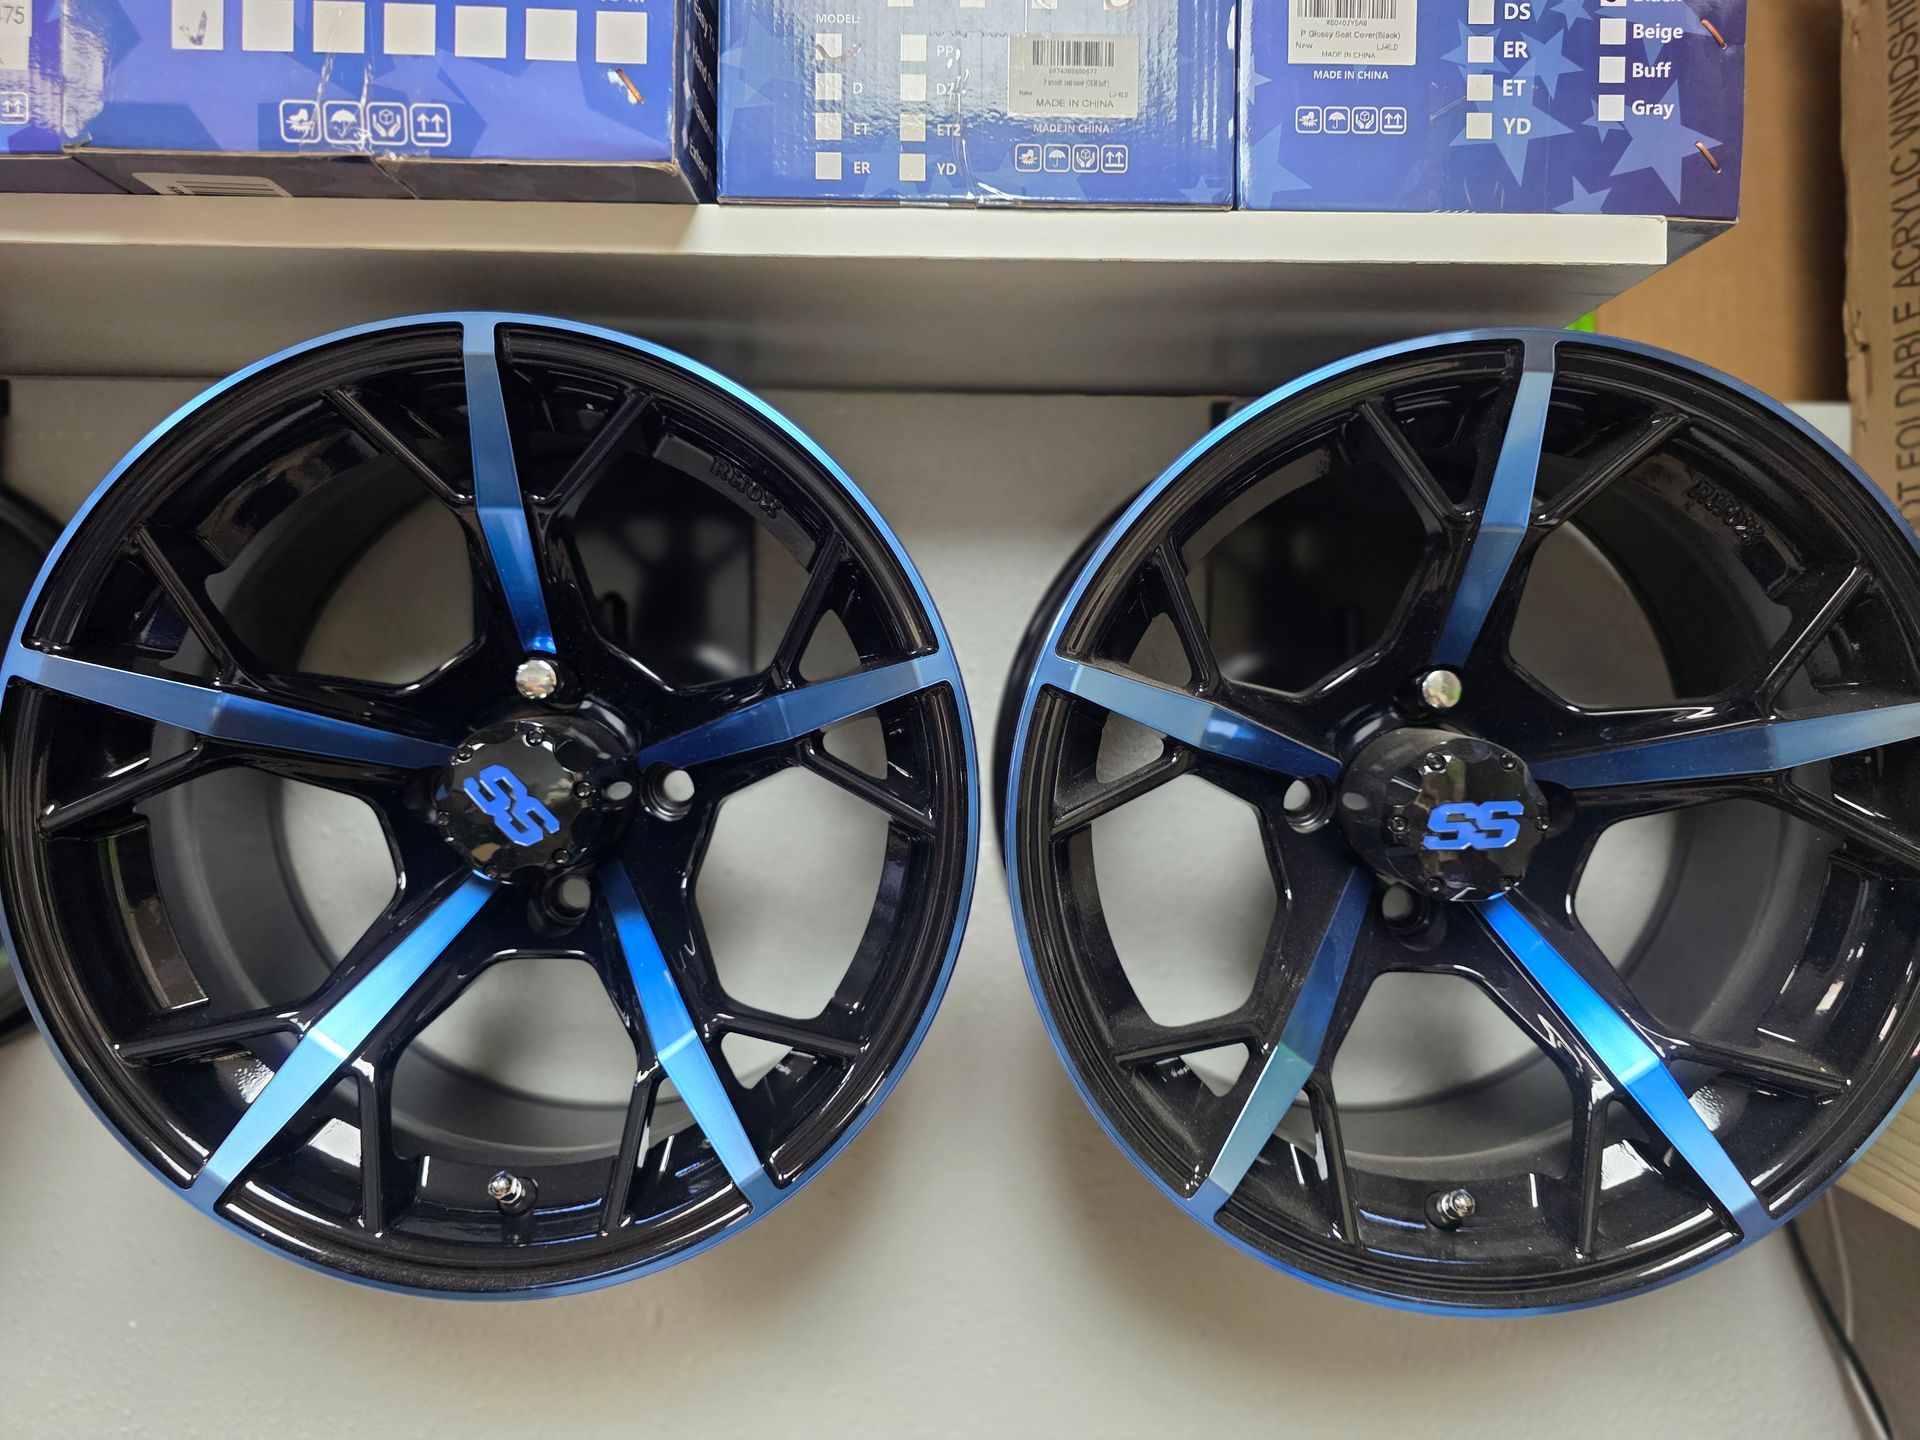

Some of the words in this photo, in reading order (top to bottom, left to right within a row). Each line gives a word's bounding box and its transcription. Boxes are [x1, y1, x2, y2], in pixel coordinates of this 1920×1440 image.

[0, 5, 25, 25] 75
[1504, 2, 1531, 20] DS
[815, 14, 861, 24] MODEL:
[1300, 30, 1306, 38] P
[1309, 30, 1333, 39] Glossy
[1335, 31, 1352, 39] Seat
[1632, 23, 1684, 43] Beige
[1353, 51, 1376, 59] CHINA
[1503, 41, 1529, 59] ER
[1313, 70, 1342, 79] MADE
[1344, 71, 1355, 79] IN
[1357, 71, 1389, 80] CHINA
[1632, 61, 1671, 79] Buff
[853, 82, 863, 94] D
[1019, 89, 1033, 97] New
[1502, 79, 1526, 97] ET
[1036, 99, 1066, 108] MADE
[1069, 99, 1079, 108] IN
[1082, 99, 1115, 108] CHINA
[1632, 100, 1675, 120] Gray
[853, 123, 870, 135] ET
[937, 124, 961, 137] ET2
[1033, 124, 1064, 133] MADE
[1065, 124, 1075, 133] IN
[1078, 124, 1110, 134] CHINA
[1503, 117, 1532, 135] YD
[853, 161, 871, 175] ER
[936, 162, 957, 176] YD
[1889, 147, 1920, 289] ACRYLIC
[463, 764, 560, 847] SS
[1422, 800, 1525, 850] SS
